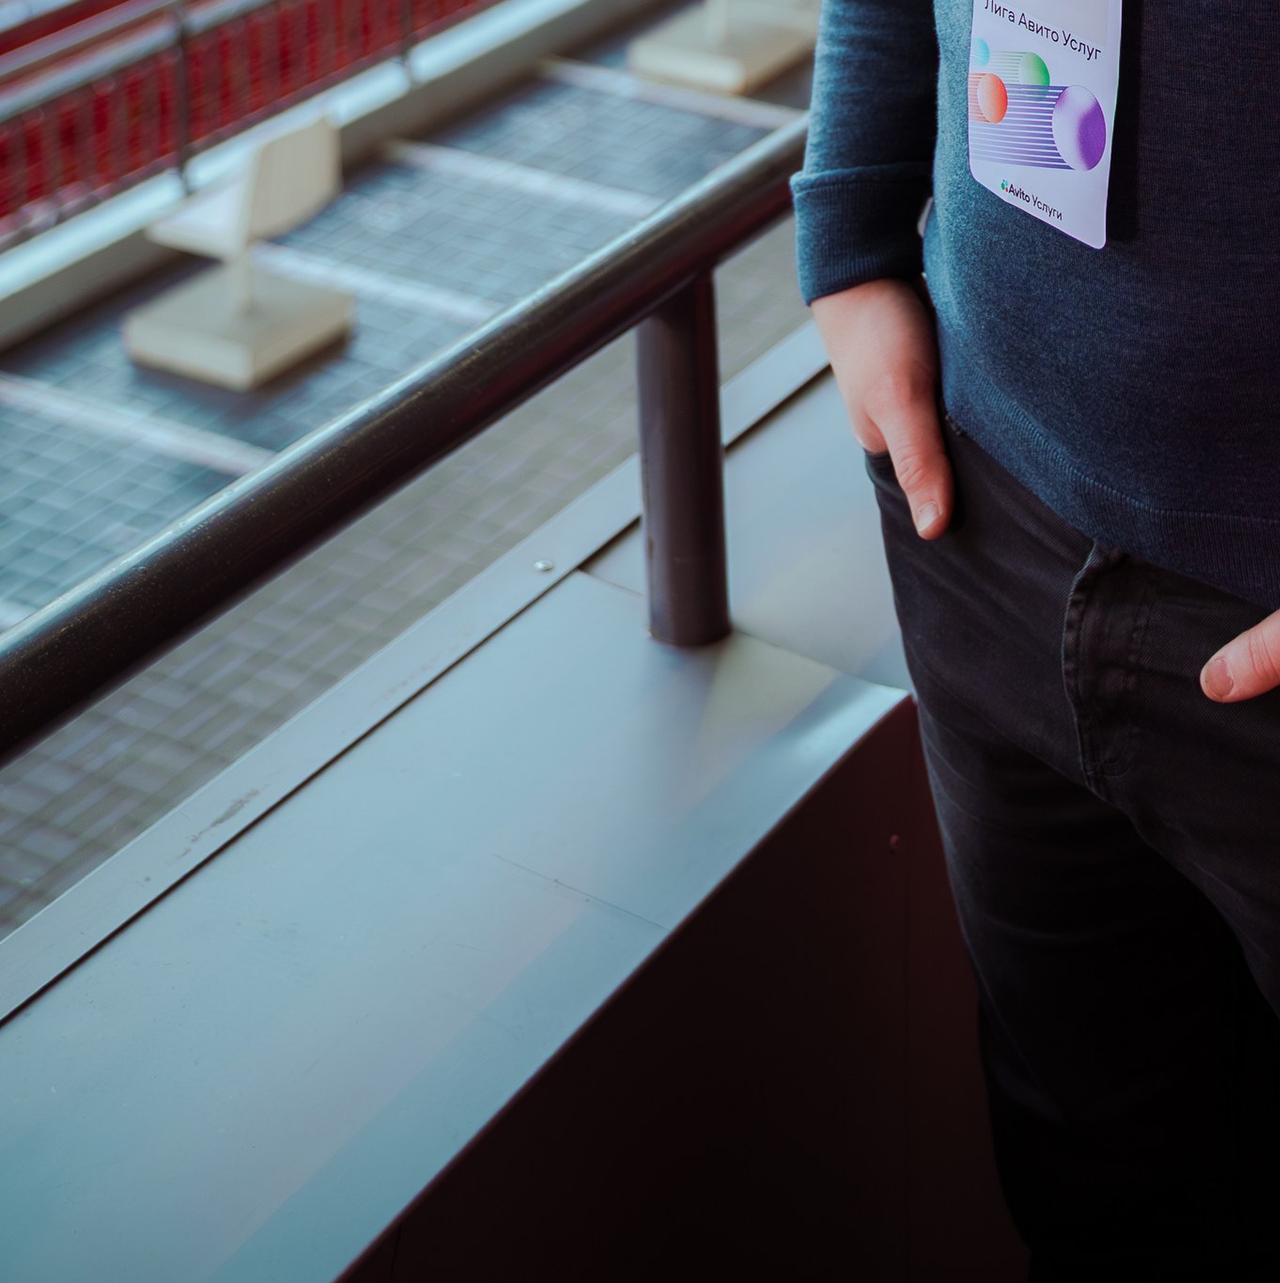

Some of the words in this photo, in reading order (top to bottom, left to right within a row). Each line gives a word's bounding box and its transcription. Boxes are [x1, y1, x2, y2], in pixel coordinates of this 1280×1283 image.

[1018, 13, 1059, 43] Авито
[1062, 30, 1102, 61] Услуг
[1008, 184, 1030, 203] Avito
[1031, 194, 1063, 221] Услуги
